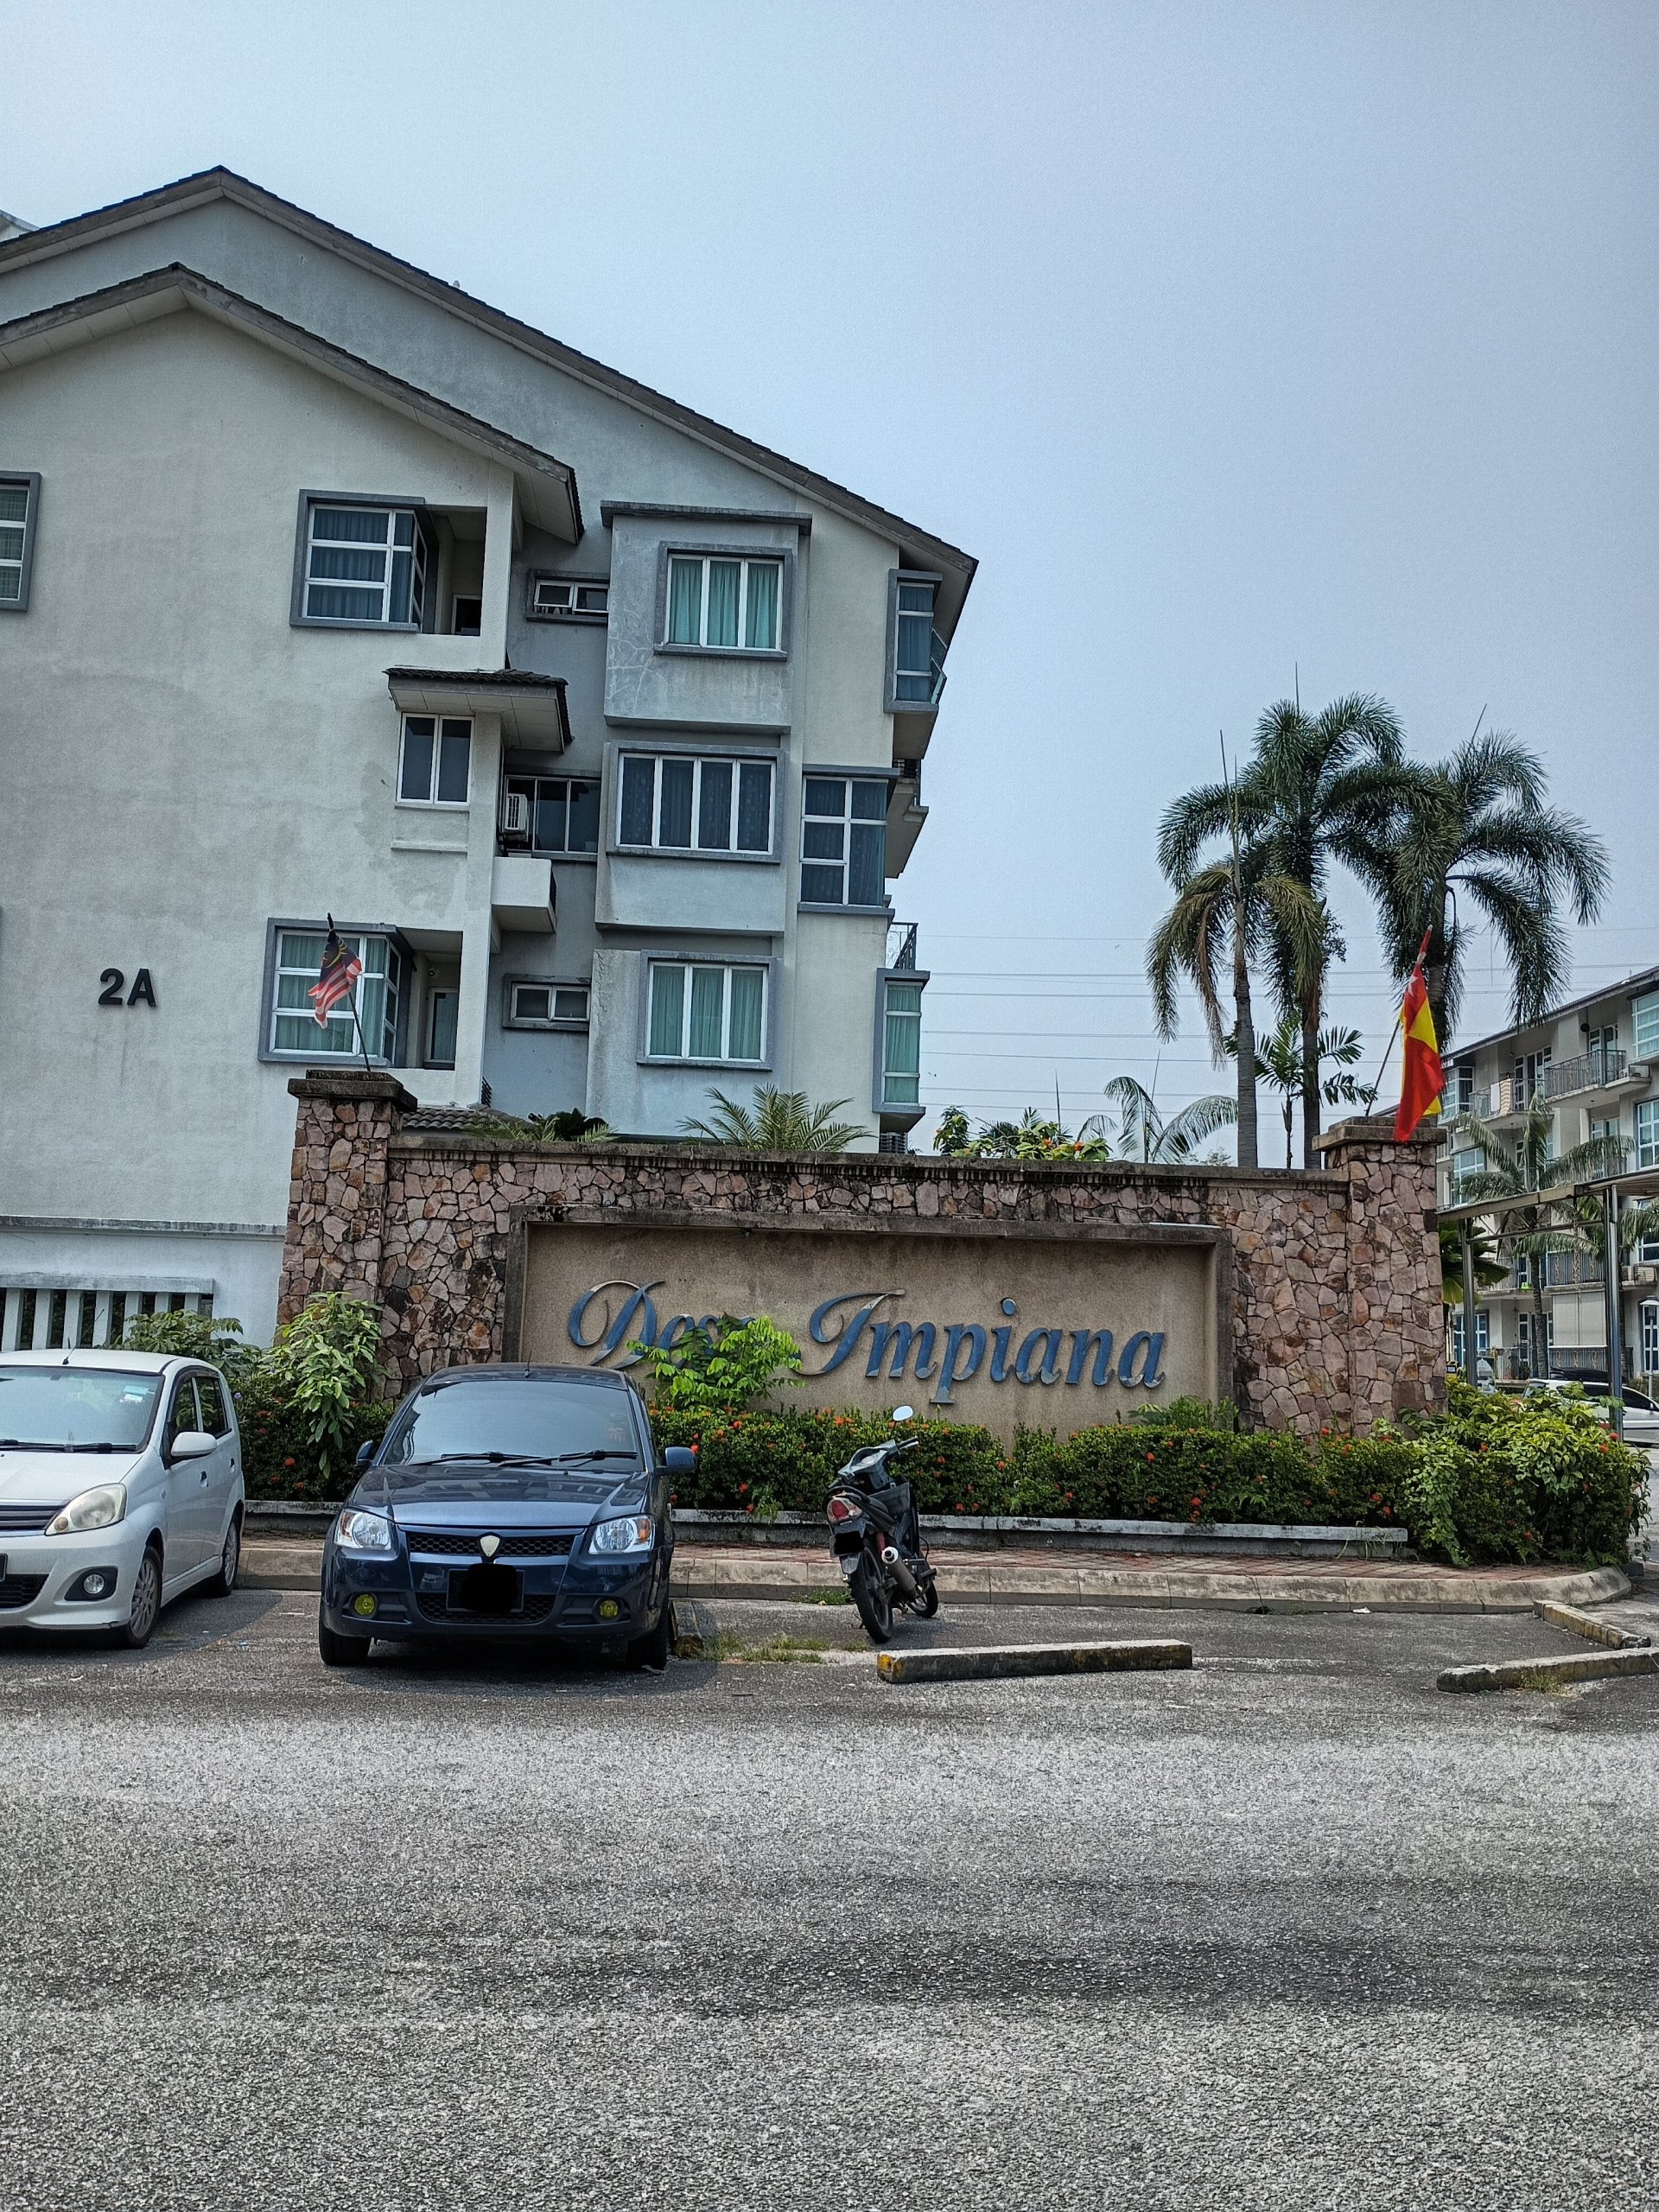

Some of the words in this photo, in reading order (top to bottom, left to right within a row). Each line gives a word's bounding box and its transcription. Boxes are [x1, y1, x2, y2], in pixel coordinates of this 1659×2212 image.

[98, 968, 156, 1007] 2A
[568, 1280, 772, 1370] Des
[789, 1289, 1166, 1404] Impiana
